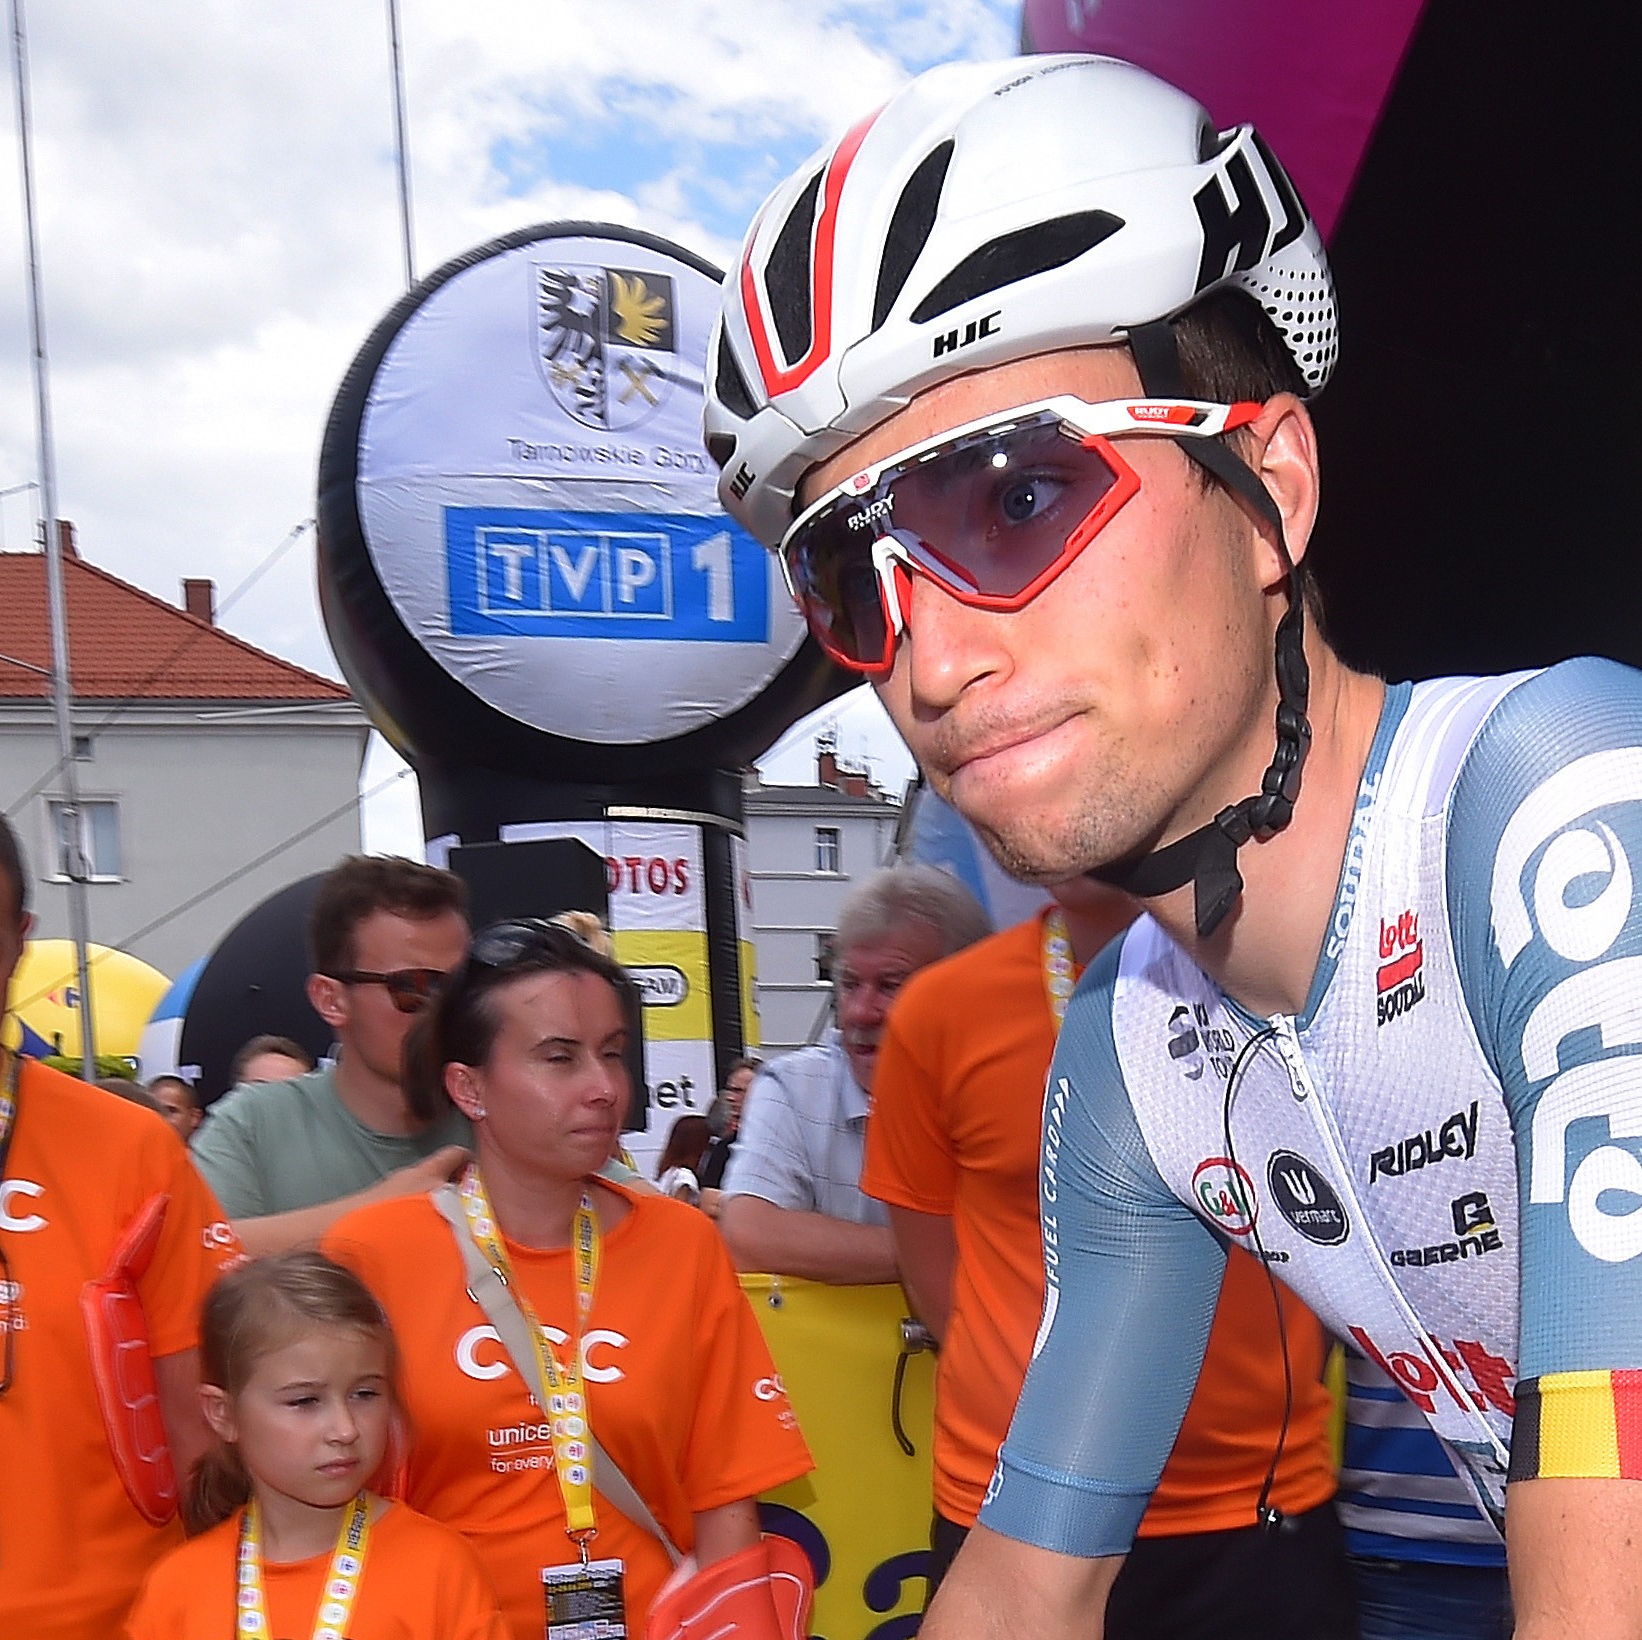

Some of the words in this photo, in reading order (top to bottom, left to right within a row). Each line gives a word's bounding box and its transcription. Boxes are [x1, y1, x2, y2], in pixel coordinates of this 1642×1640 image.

[933, 310, 1002, 358] HJC
[730, 461, 756, 500] HJC
[488, 542, 657, 604] TVP
[691, 530, 735, 622] 1
[606, 857, 690, 895] OTOS
[1043, 1125, 1062, 1202] CARD
[1369, 1100, 1480, 1186] RIDLEY
[1043, 1215, 1060, 1283] FUEL
[487, 1421, 552, 1447] unice
